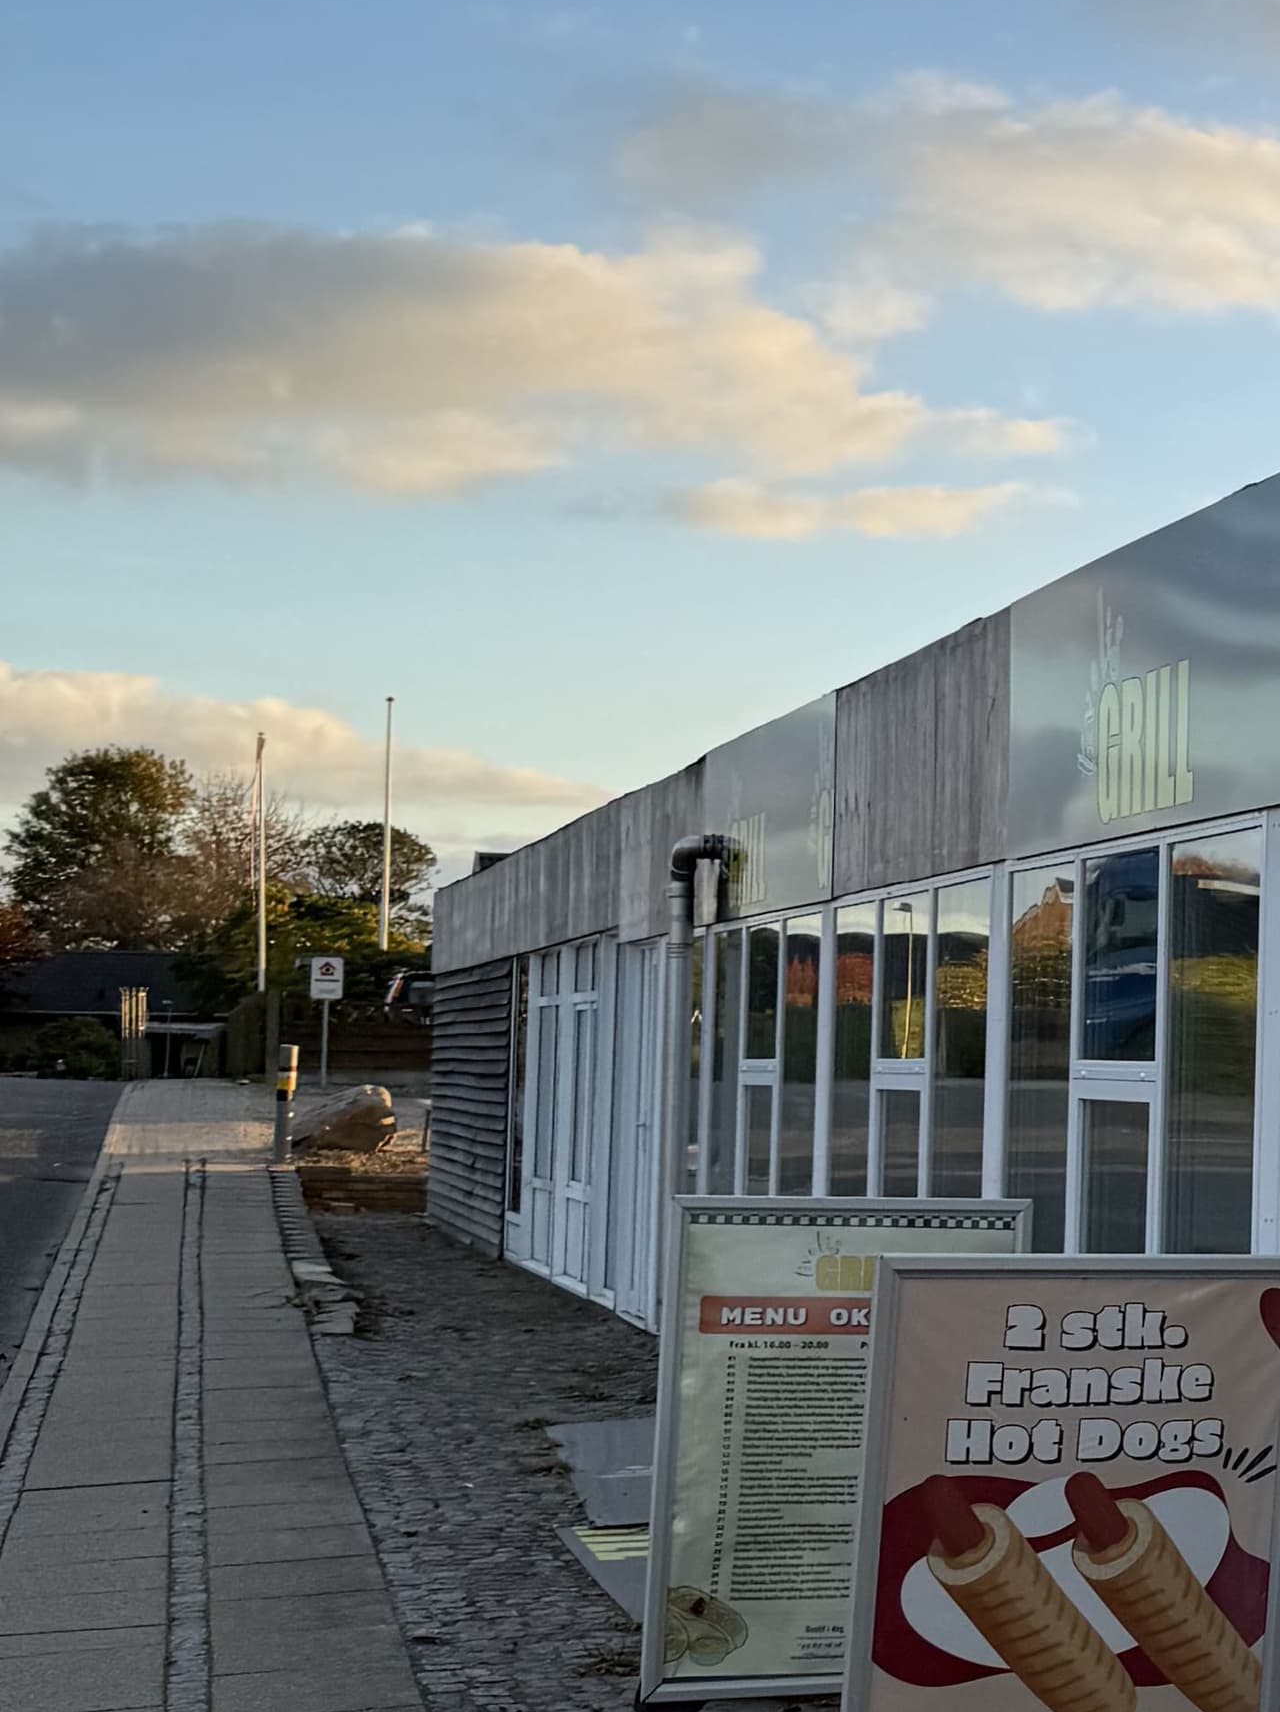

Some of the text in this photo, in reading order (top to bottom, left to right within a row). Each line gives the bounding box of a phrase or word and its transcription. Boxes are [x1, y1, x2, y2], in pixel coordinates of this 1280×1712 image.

[1097, 659, 1194, 825] GRILL
[720, 1306, 869, 1327] MENU OK
[1003, 1302, 1188, 1350] 2 stk.
[965, 1357, 1214, 1407] Franske
[945, 1417, 1223, 1464] Hot Dogs
